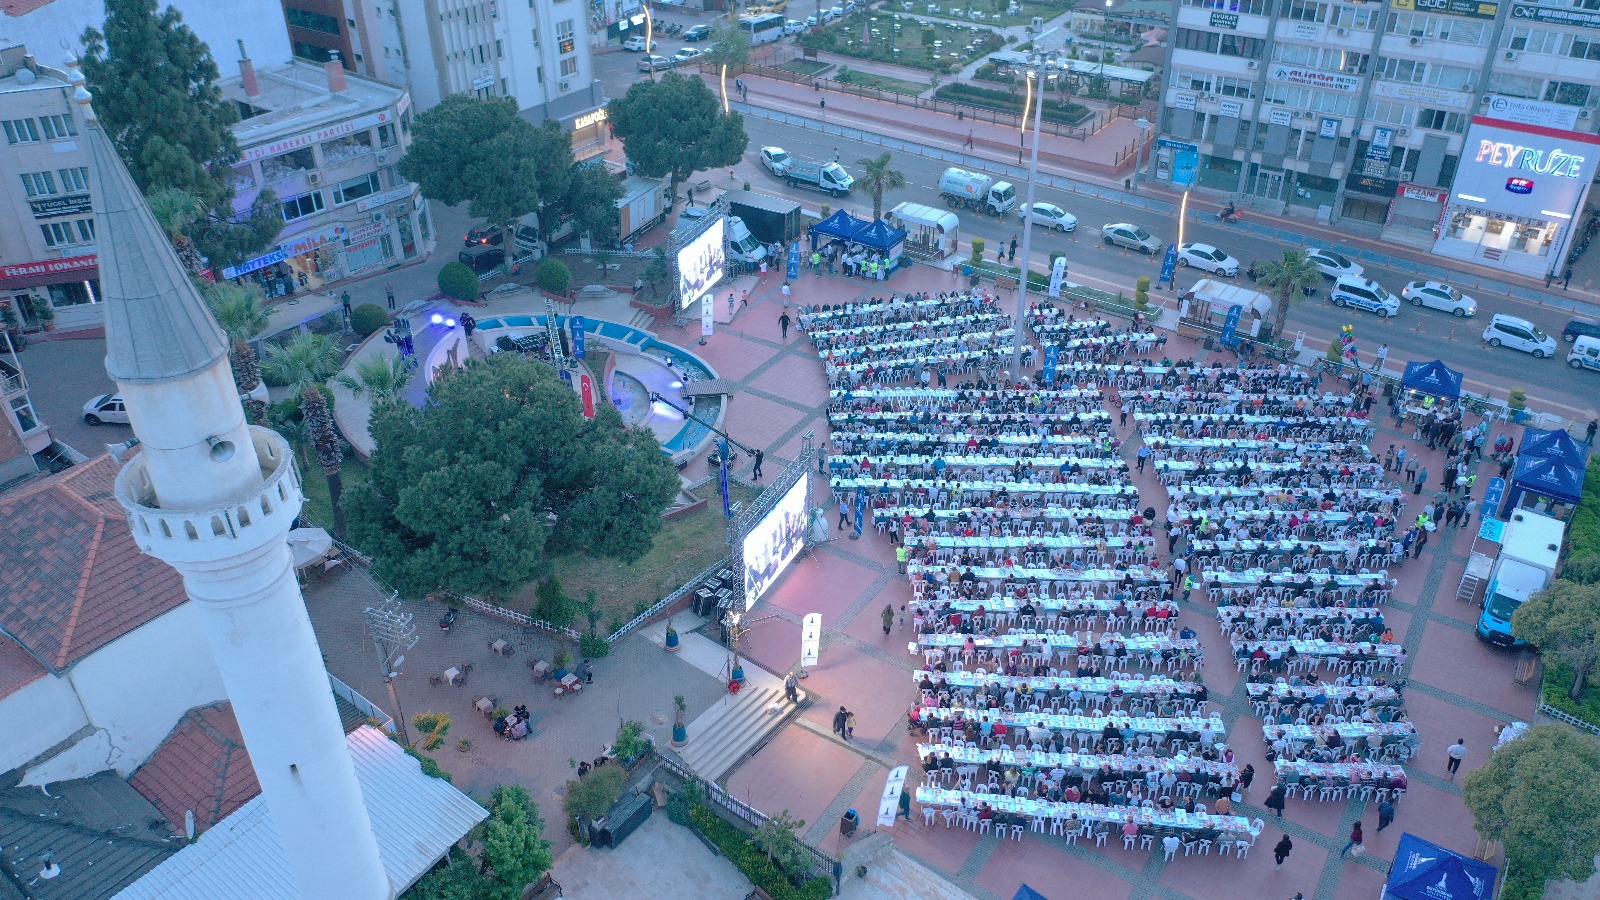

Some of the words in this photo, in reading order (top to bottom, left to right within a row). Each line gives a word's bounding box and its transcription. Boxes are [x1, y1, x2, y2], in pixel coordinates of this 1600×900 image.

[1289, 70, 1334, 82] ALİAĞA
[269, 135, 312, 153] HAREKET
[317, 121, 354, 140] PARTİSİ
[1406, 187, 1438, 199] ECZANE
[294, 235, 328, 254] MİLA
[5, 265, 46, 276] FERAH
[48, 259, 97, 271] LOKANT
